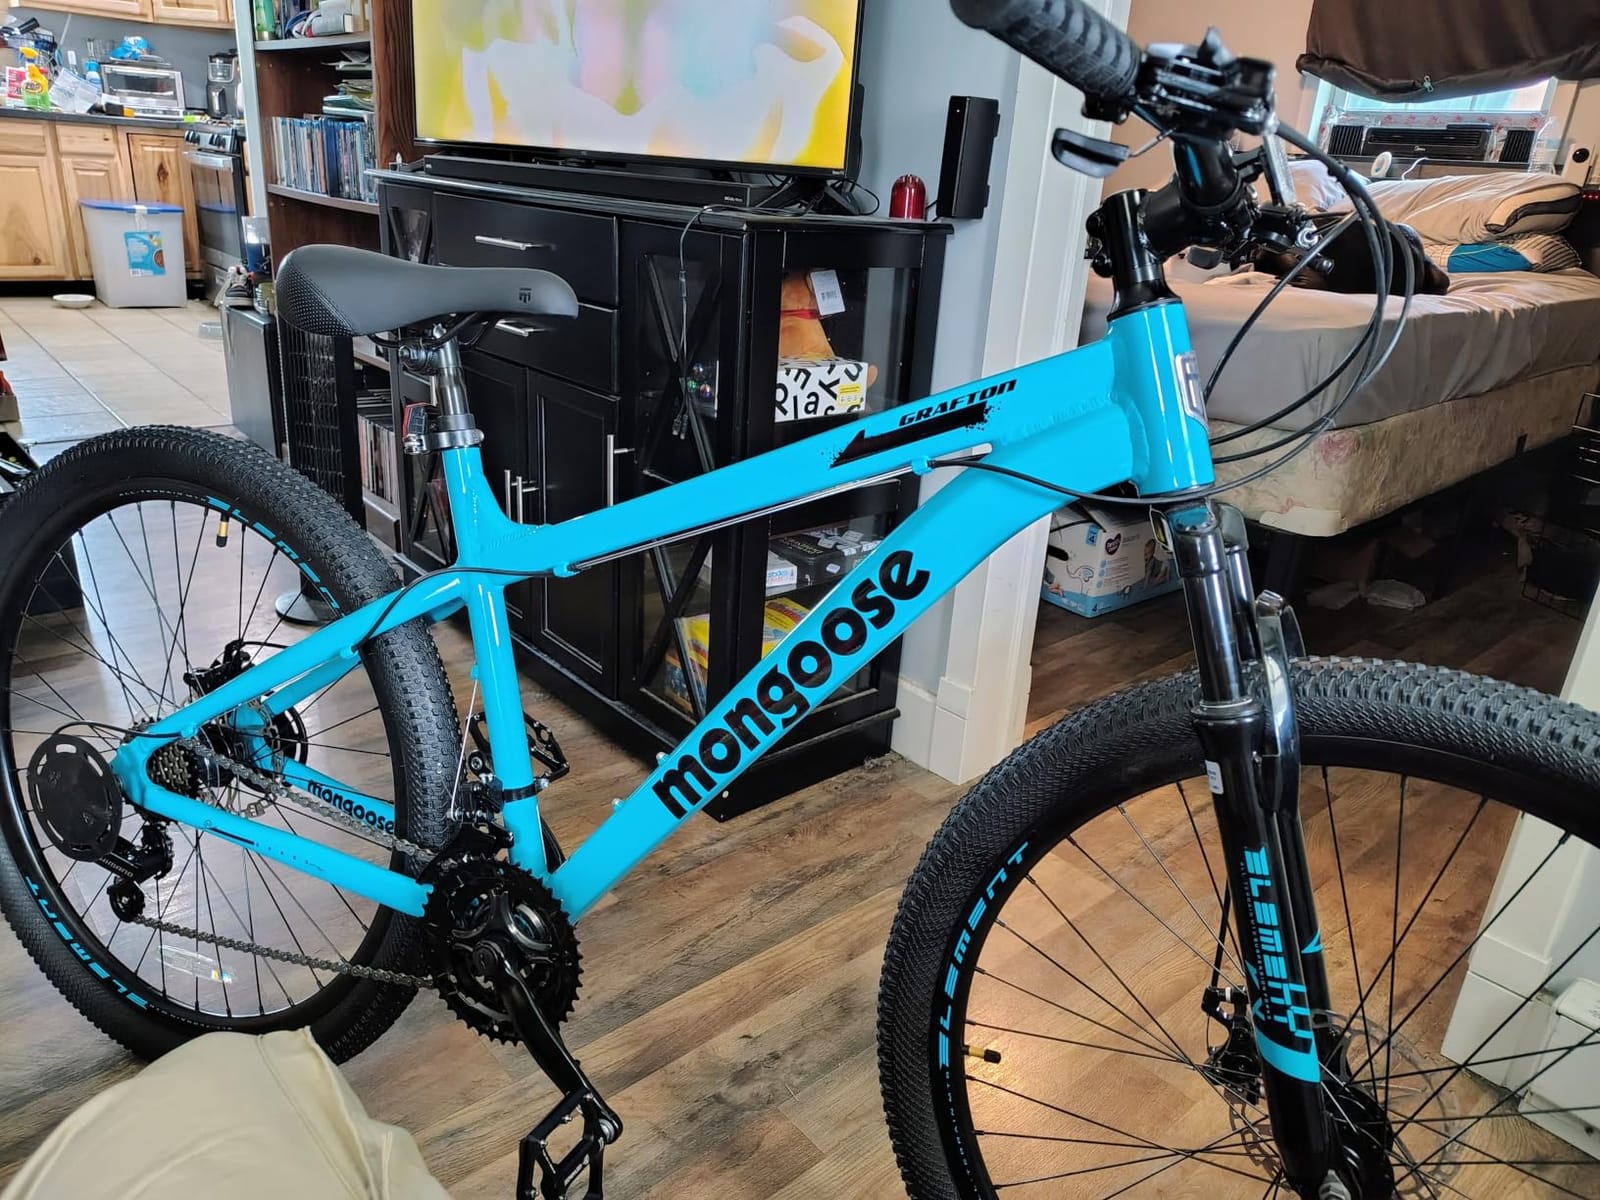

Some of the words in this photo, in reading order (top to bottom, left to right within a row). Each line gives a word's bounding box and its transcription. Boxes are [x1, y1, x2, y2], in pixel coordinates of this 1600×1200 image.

[898, 379, 1017, 427] GRAFTON
[205, 495, 340, 610] ELEMEN
[651, 550, 931, 820] mongoose
[308, 780, 395, 835] mongoose
[25, 876, 149, 1010] ELEMENT
[938, 841, 1029, 1070] ELEMENT
[1244, 847, 1300, 1034] ELEMENT
